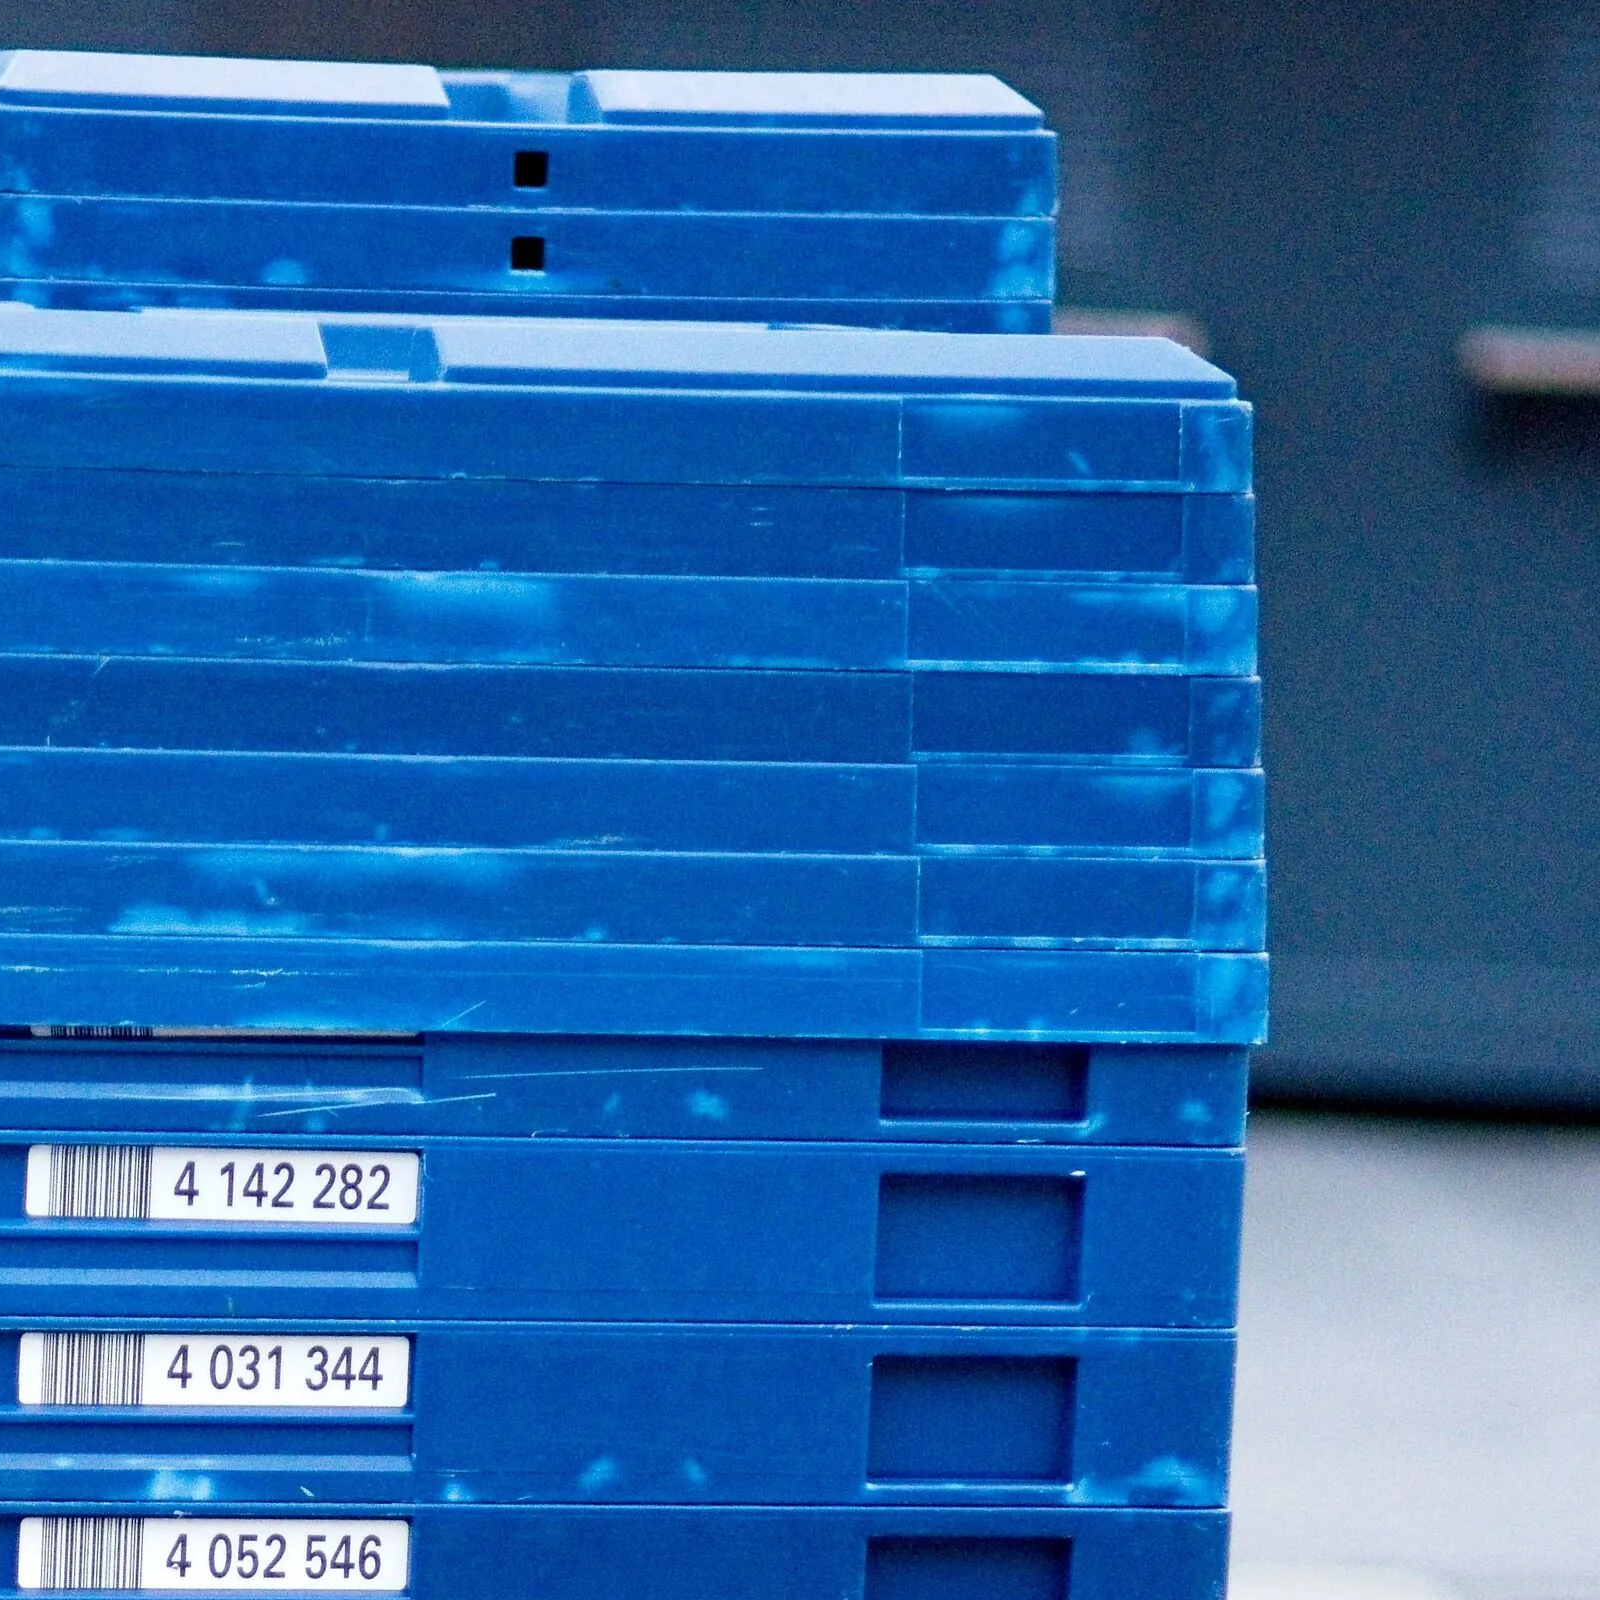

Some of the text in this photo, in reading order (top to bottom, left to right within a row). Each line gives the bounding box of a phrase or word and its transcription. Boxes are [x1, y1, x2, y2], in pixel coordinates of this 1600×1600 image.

[173, 1161, 391, 1210] 4 142 282
[167, 1344, 383, 1391] 4 031 344
[166, 1533, 382, 1580] 4 052 546
